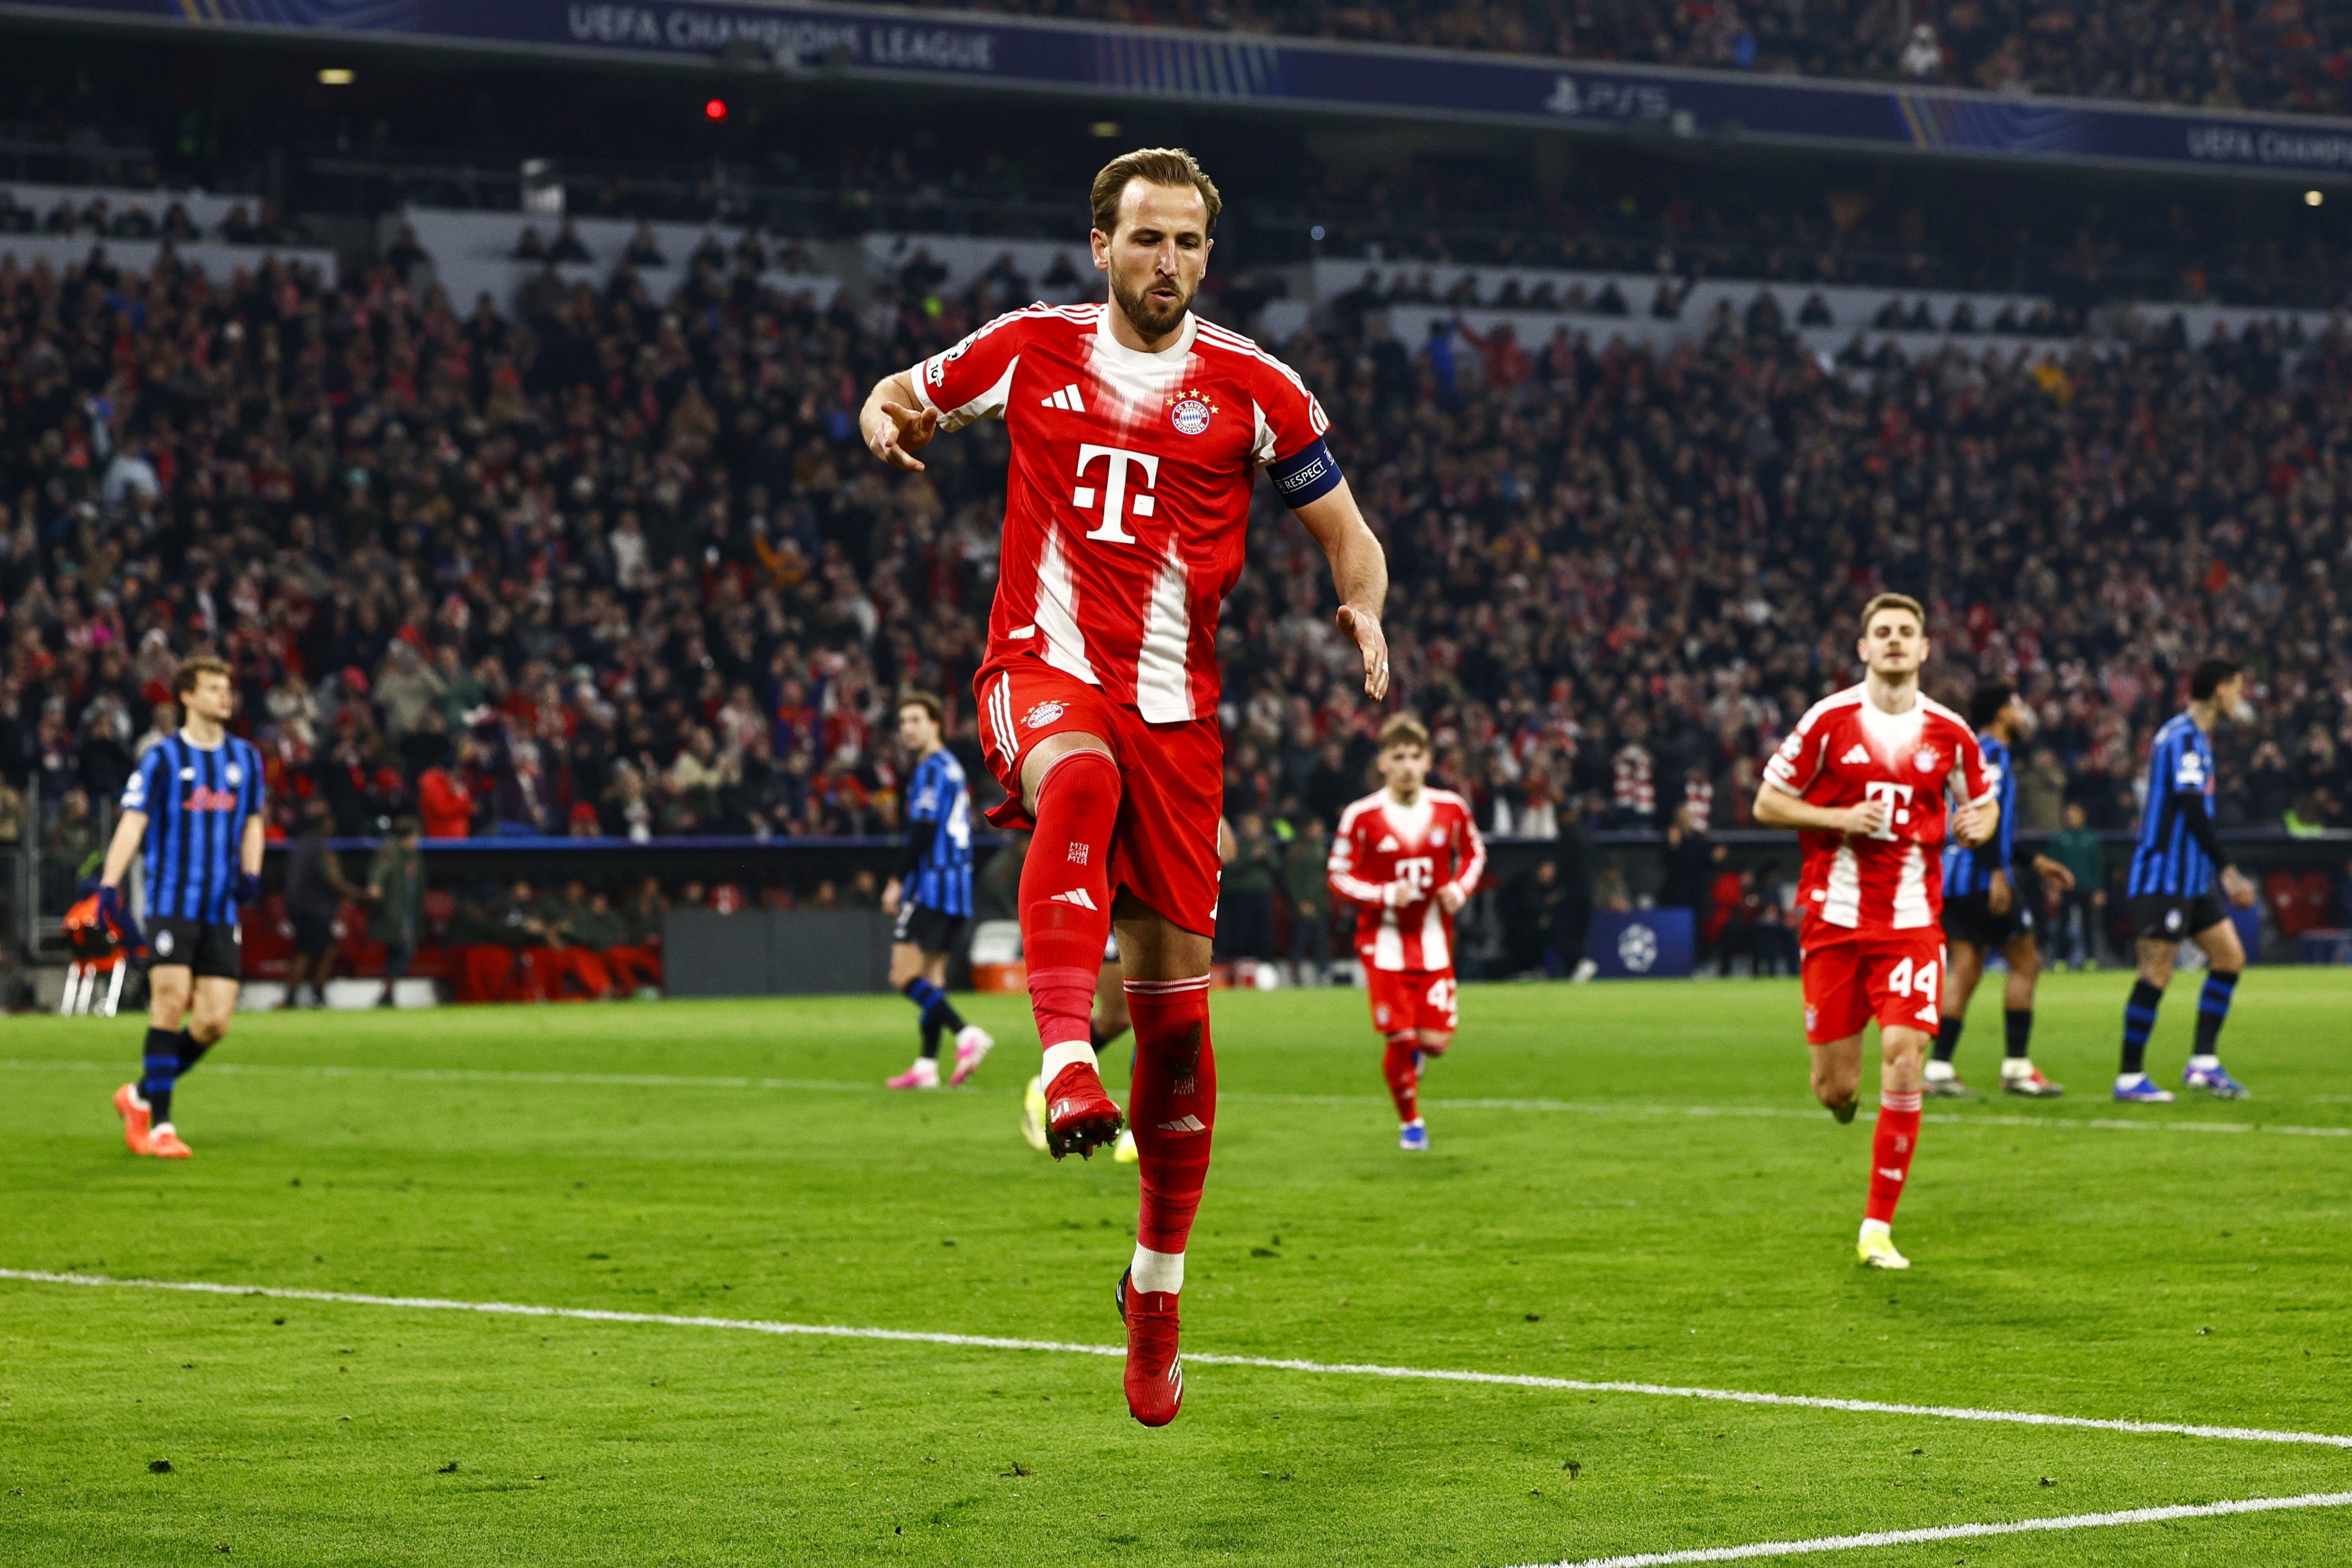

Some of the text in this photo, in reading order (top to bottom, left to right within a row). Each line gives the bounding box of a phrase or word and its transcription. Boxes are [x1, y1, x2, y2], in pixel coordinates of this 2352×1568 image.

[568, 4, 661, 44] UEFA
[869, 27, 994, 70] LEAGUE
[2186, 127, 2254, 159] UEFA
[1176, 402, 1207, 418] FC BAYERN
[1284, 460, 1324, 489] RESPECT
[1073, 443, 1159, 544] T
[1066, 854, 1087, 866] MIA
[1068, 848, 1088, 859] SAN
[1069, 842, 1089, 851] MIA
[1888, 956, 1938, 1003] 44
